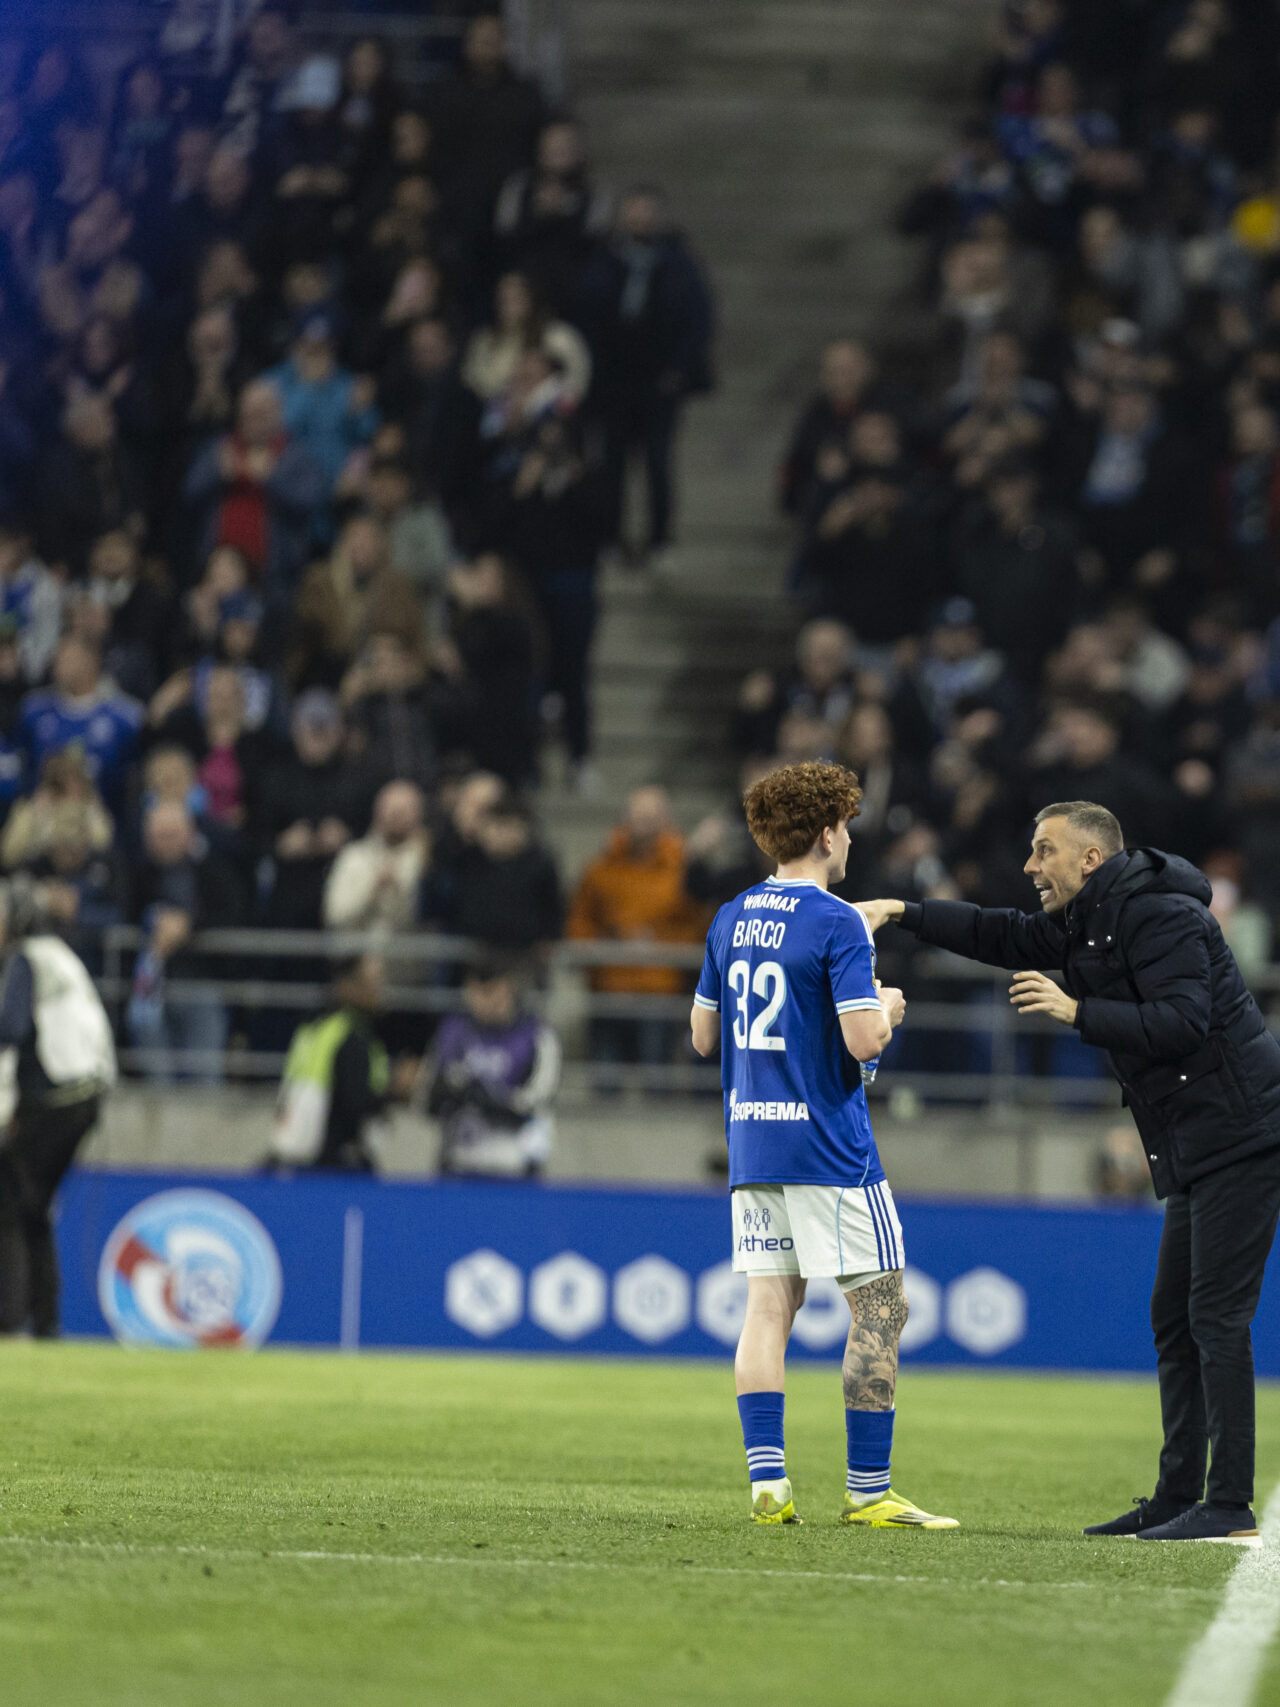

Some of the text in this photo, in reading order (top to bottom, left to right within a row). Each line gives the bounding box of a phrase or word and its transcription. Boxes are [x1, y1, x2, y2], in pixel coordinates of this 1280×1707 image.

[744, 893, 800, 912] WINAMAX
[732, 918, 786, 950] BARCO
[728, 960, 787, 1051] 32
[734, 1101, 810, 1121] SOPREMA
